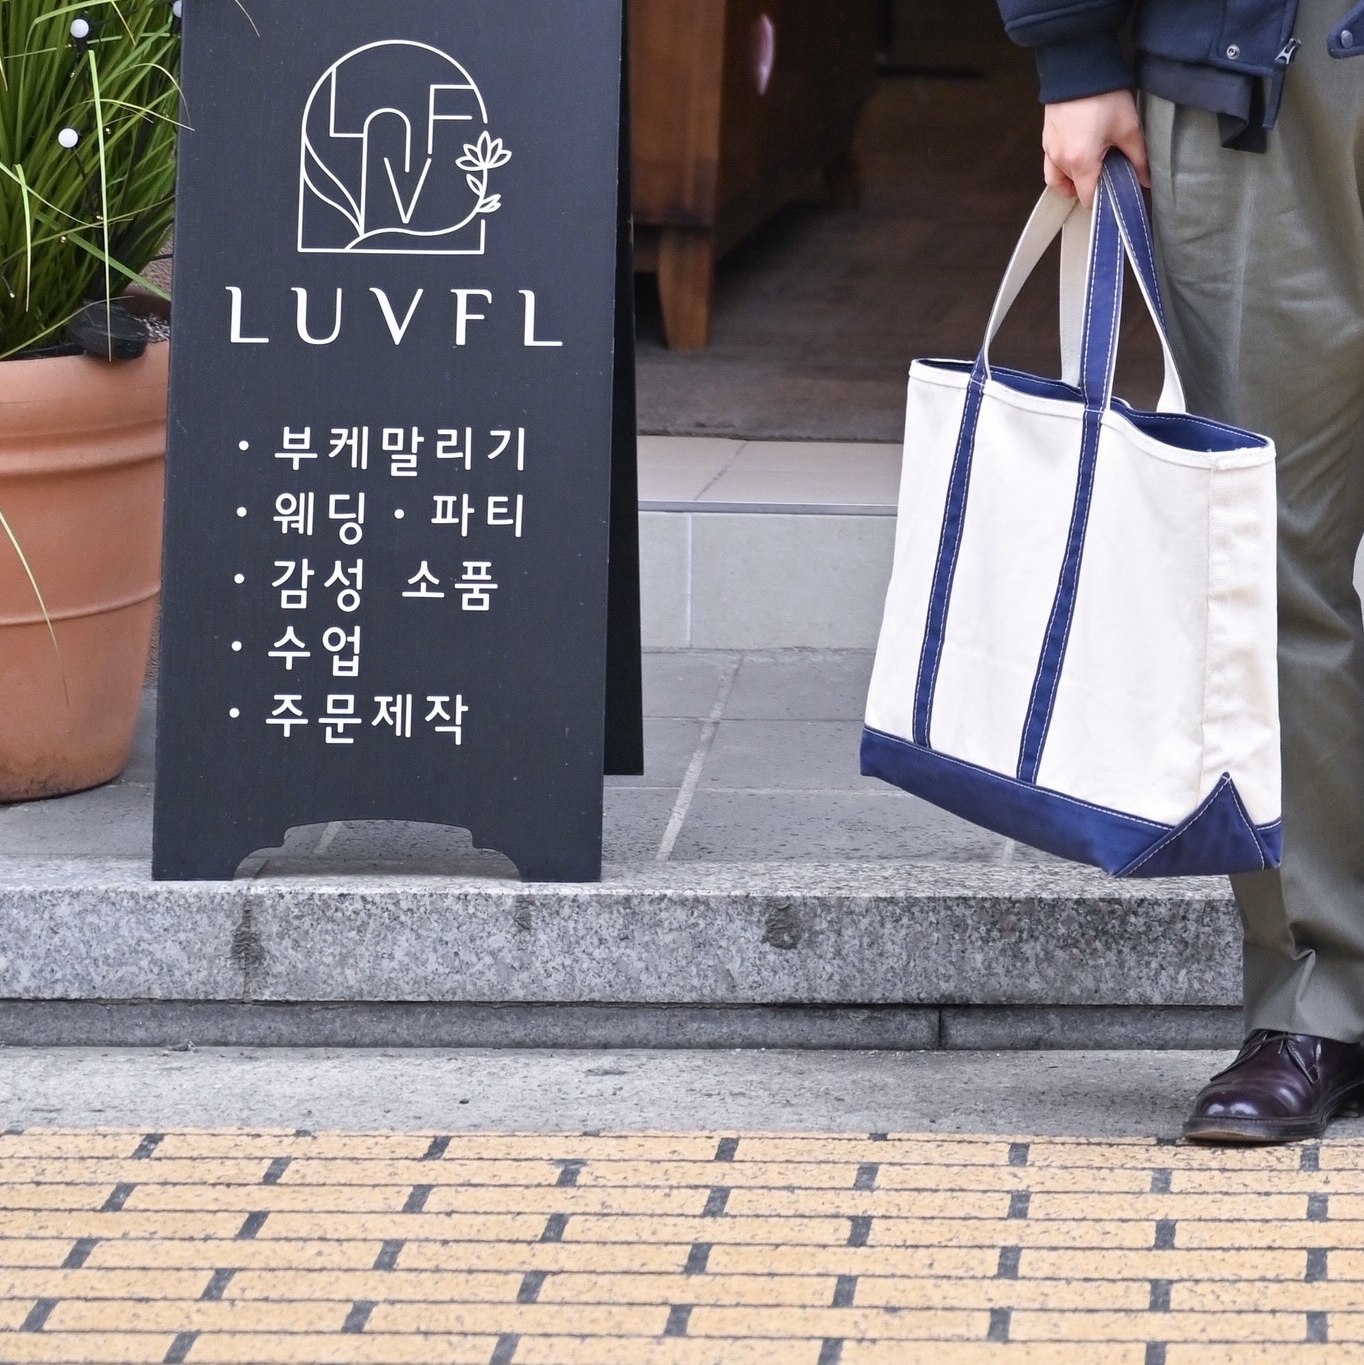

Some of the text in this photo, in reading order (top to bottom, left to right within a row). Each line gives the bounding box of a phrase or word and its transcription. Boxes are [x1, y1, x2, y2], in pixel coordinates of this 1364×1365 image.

[225, 285, 563, 347] LUVFL
[274, 426, 525, 477] 부케말리기
[273, 492, 524, 545] 웨딩 파티
[271, 558, 499, 612] 감성 소품
[268, 625, 361, 677] 수업
[265, 693, 469, 746] 주문제작
